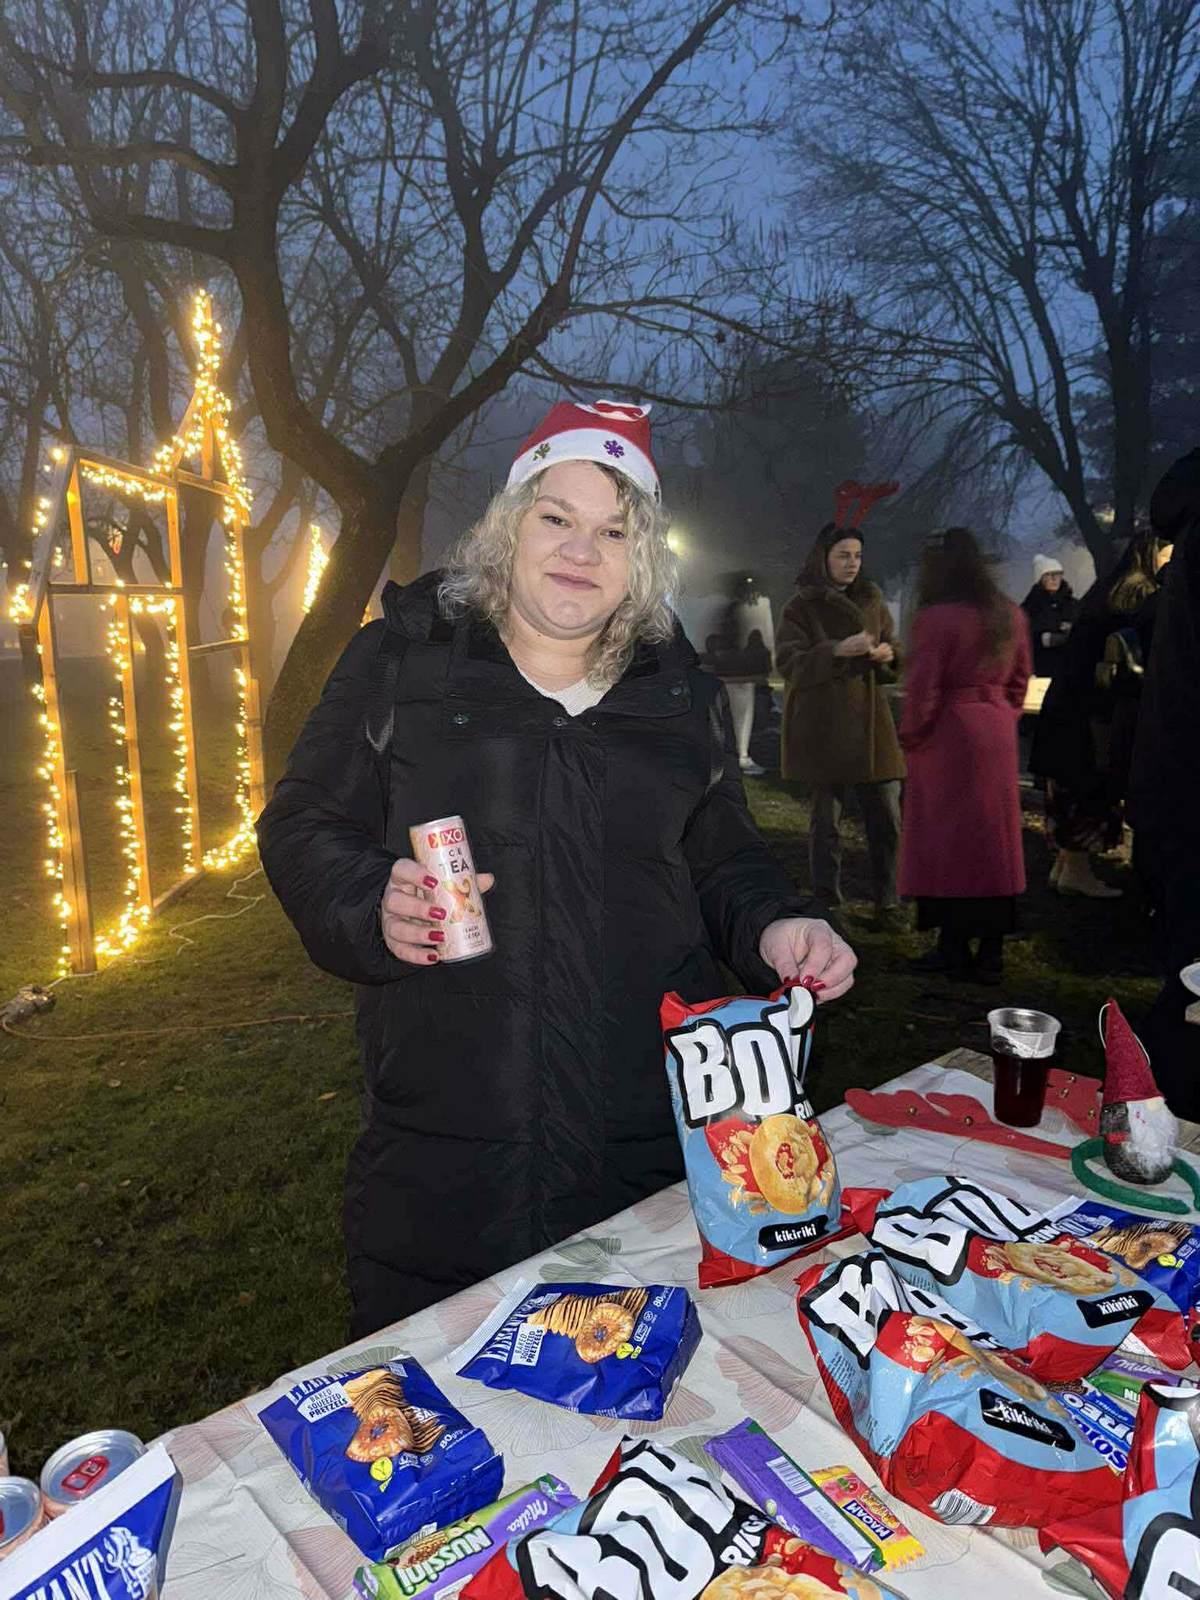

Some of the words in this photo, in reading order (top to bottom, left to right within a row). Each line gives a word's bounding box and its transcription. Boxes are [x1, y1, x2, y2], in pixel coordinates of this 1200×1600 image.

[775, 1223, 817, 1243] kikiriki
[1096, 1295, 1139, 1316] kikiriki
[526, 1328, 544, 1364] PRETZELS
[1114, 1358, 1165, 1376] Milka
[307, 1392, 342, 1411] SQUEEZED
[309, 1388, 332, 1403] BAKED
[308, 1397, 349, 1419] PRETZELS
[505, 1498, 548, 1532] Milka
[846, 1501, 891, 1538] MAOAM
